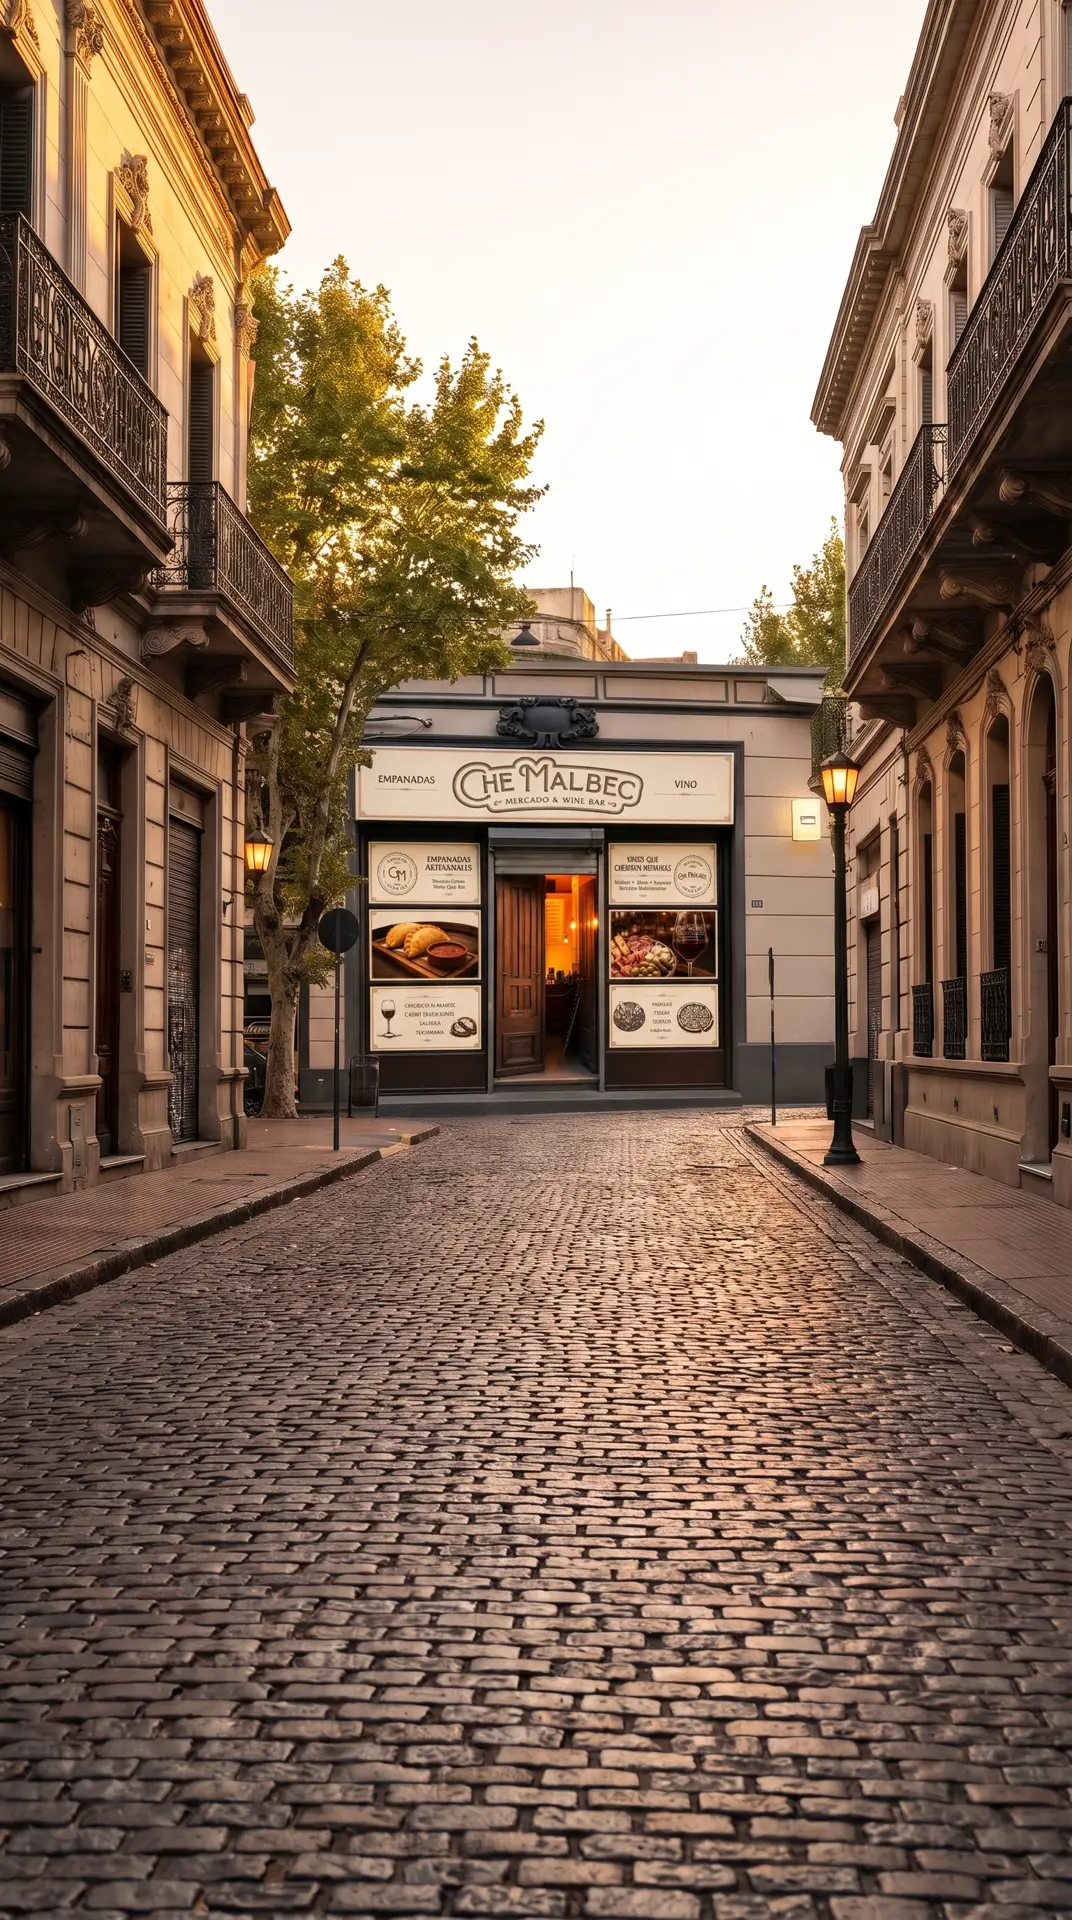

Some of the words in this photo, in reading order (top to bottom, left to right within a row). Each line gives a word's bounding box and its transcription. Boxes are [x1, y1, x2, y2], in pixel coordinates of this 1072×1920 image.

[378, 775, 436, 785] EMPANADAS
[460, 768, 515, 802] CHE
[518, 764, 636, 801] MALBEC
[674, 780, 698, 789] VINO
[505, 796, 550, 805] MERCADO
[552, 796, 559, 804] &
[562, 796, 586, 805] WINE
[588, 798, 605, 806] BAR
